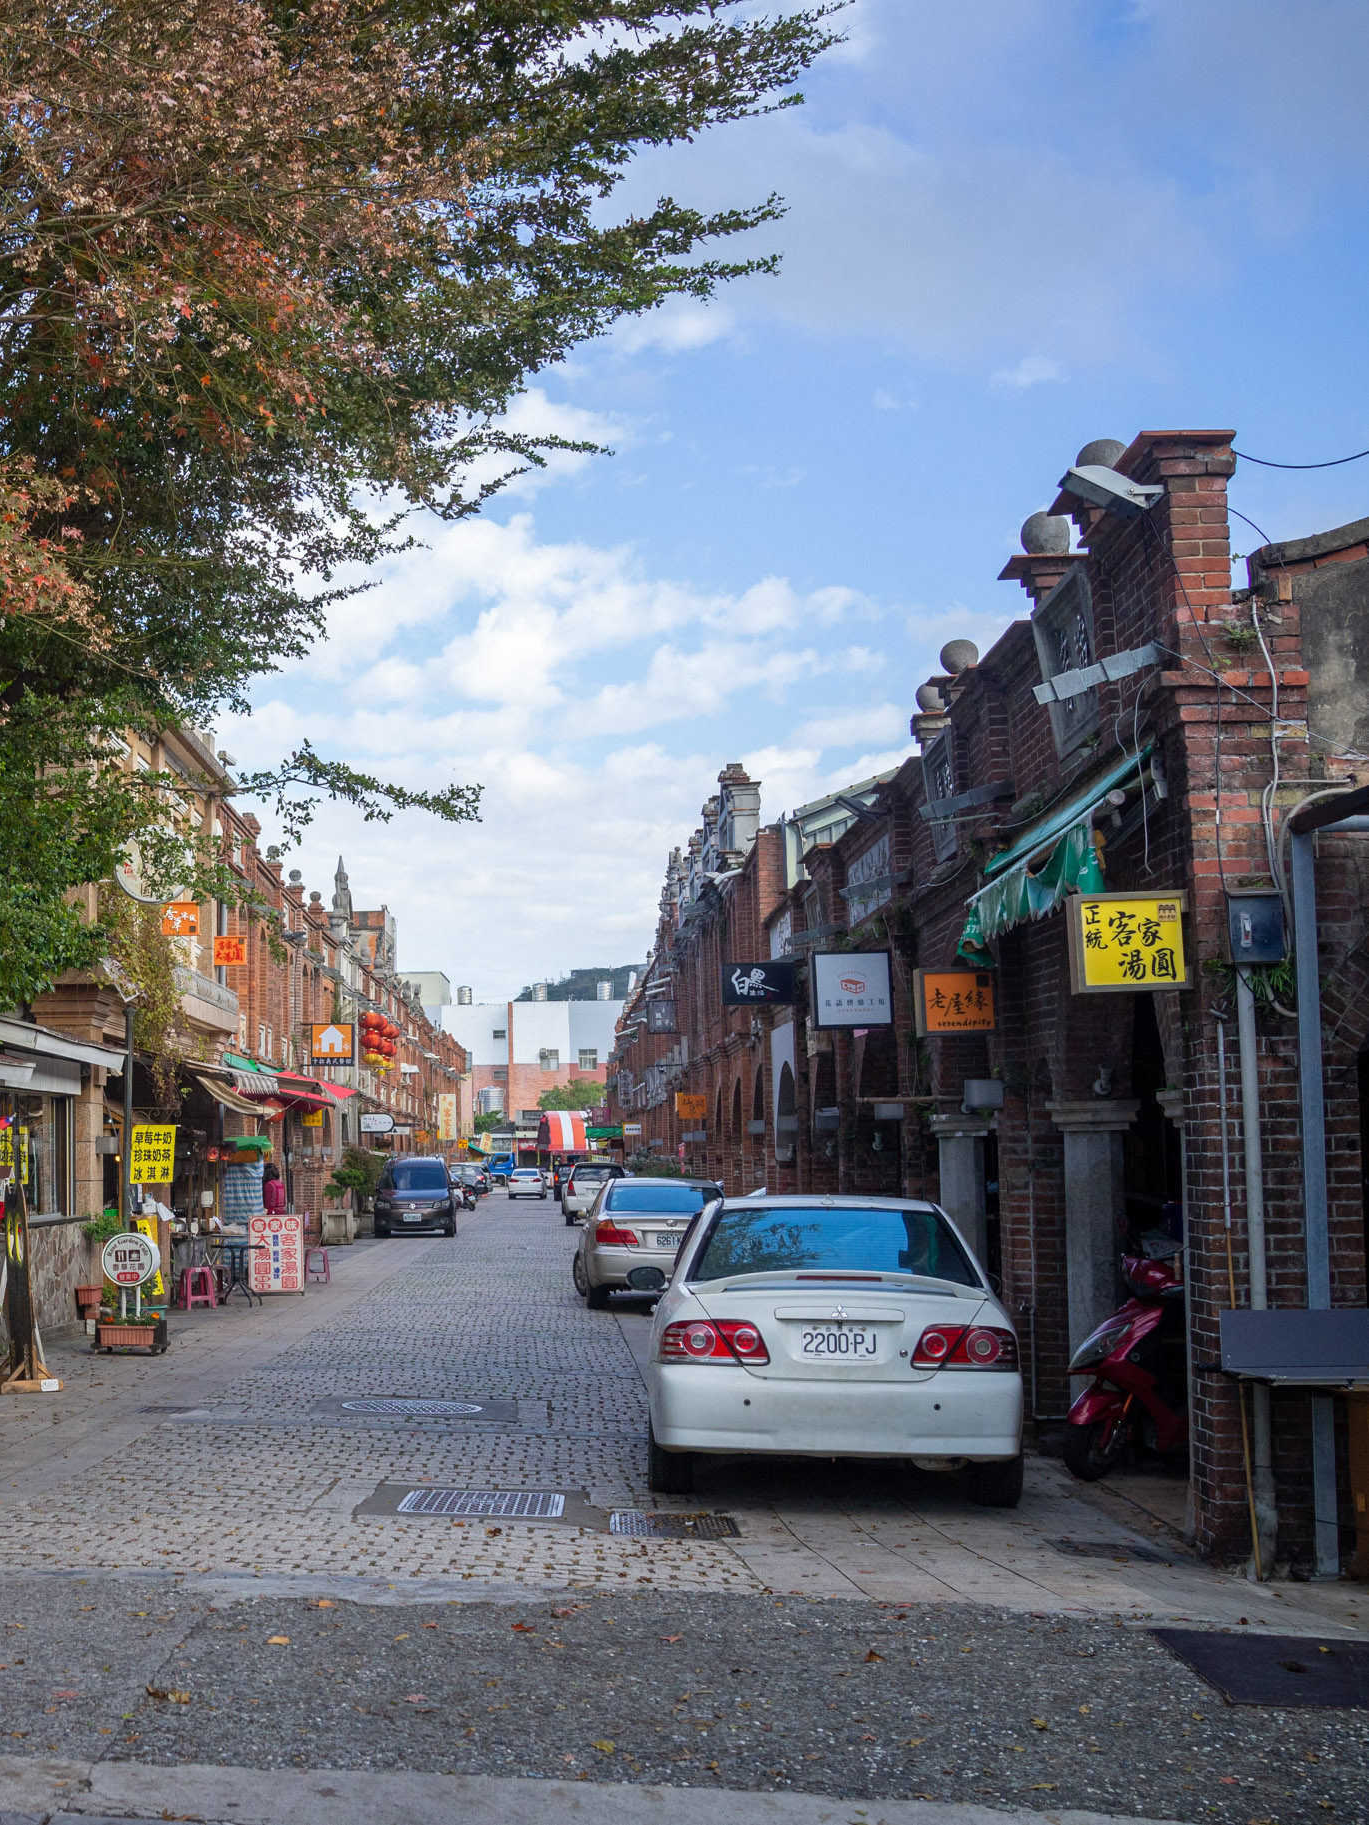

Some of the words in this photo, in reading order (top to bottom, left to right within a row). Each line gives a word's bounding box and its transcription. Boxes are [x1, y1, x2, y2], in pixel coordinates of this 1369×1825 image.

[1084, 904, 1109, 950] 正統
[1108, 911, 1164, 947] 客家
[1117, 947, 1177, 981] 湯圓
[927, 988, 990, 1017] 老屋緣
[937, 1018, 992, 1028] serendipity
[134, 1131, 172, 1145] 草莓牛奶
[134, 1148, 171, 1163] 珍珠奶茶
[133, 1166, 170, 1180] 冰淇淋
[254, 1220, 298, 1232] 客家味
[107, 1244, 118, 1257] Rose
[117, 1238, 139, 1246] Garden
[254, 1233, 271, 1275] 大湯圓
[280, 1233, 298, 1289] 客家湯圓
